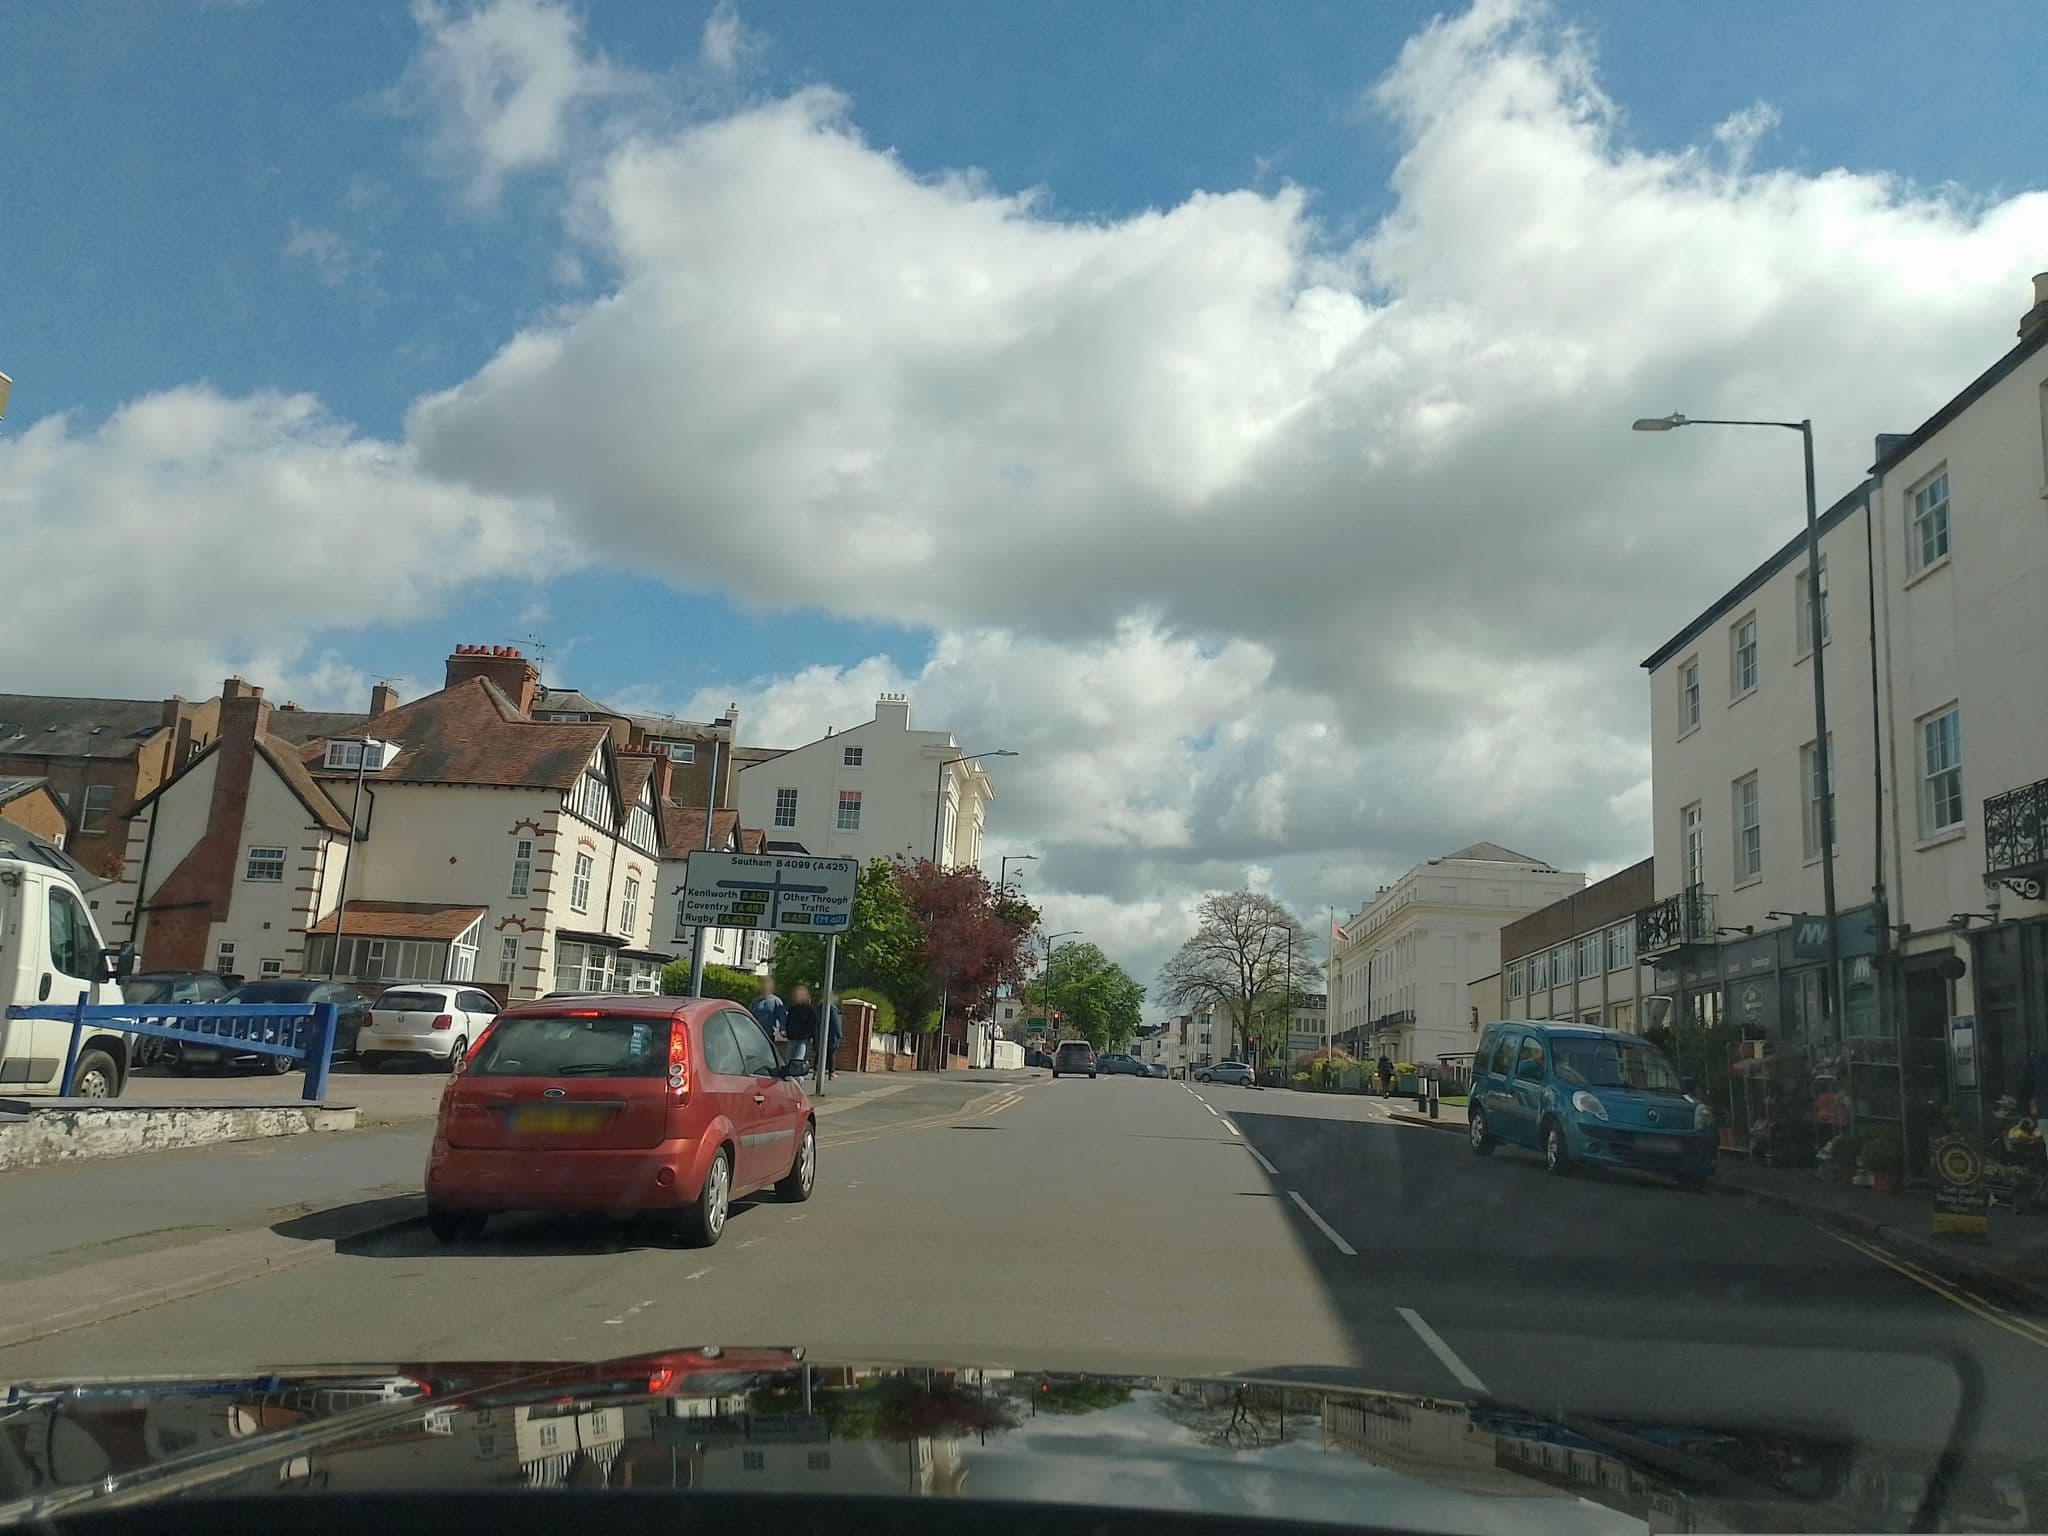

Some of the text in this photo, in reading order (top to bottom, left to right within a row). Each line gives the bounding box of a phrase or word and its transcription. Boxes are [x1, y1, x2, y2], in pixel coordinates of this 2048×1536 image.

[731, 857, 772, 867] Southam
[688, 888, 737, 899] Kenilworth
[783, 893, 848, 905] Other Through
[687, 901, 729, 912] Coventry
[800, 903, 831, 912] Traffic
[685, 913, 714, 923] Rugby
